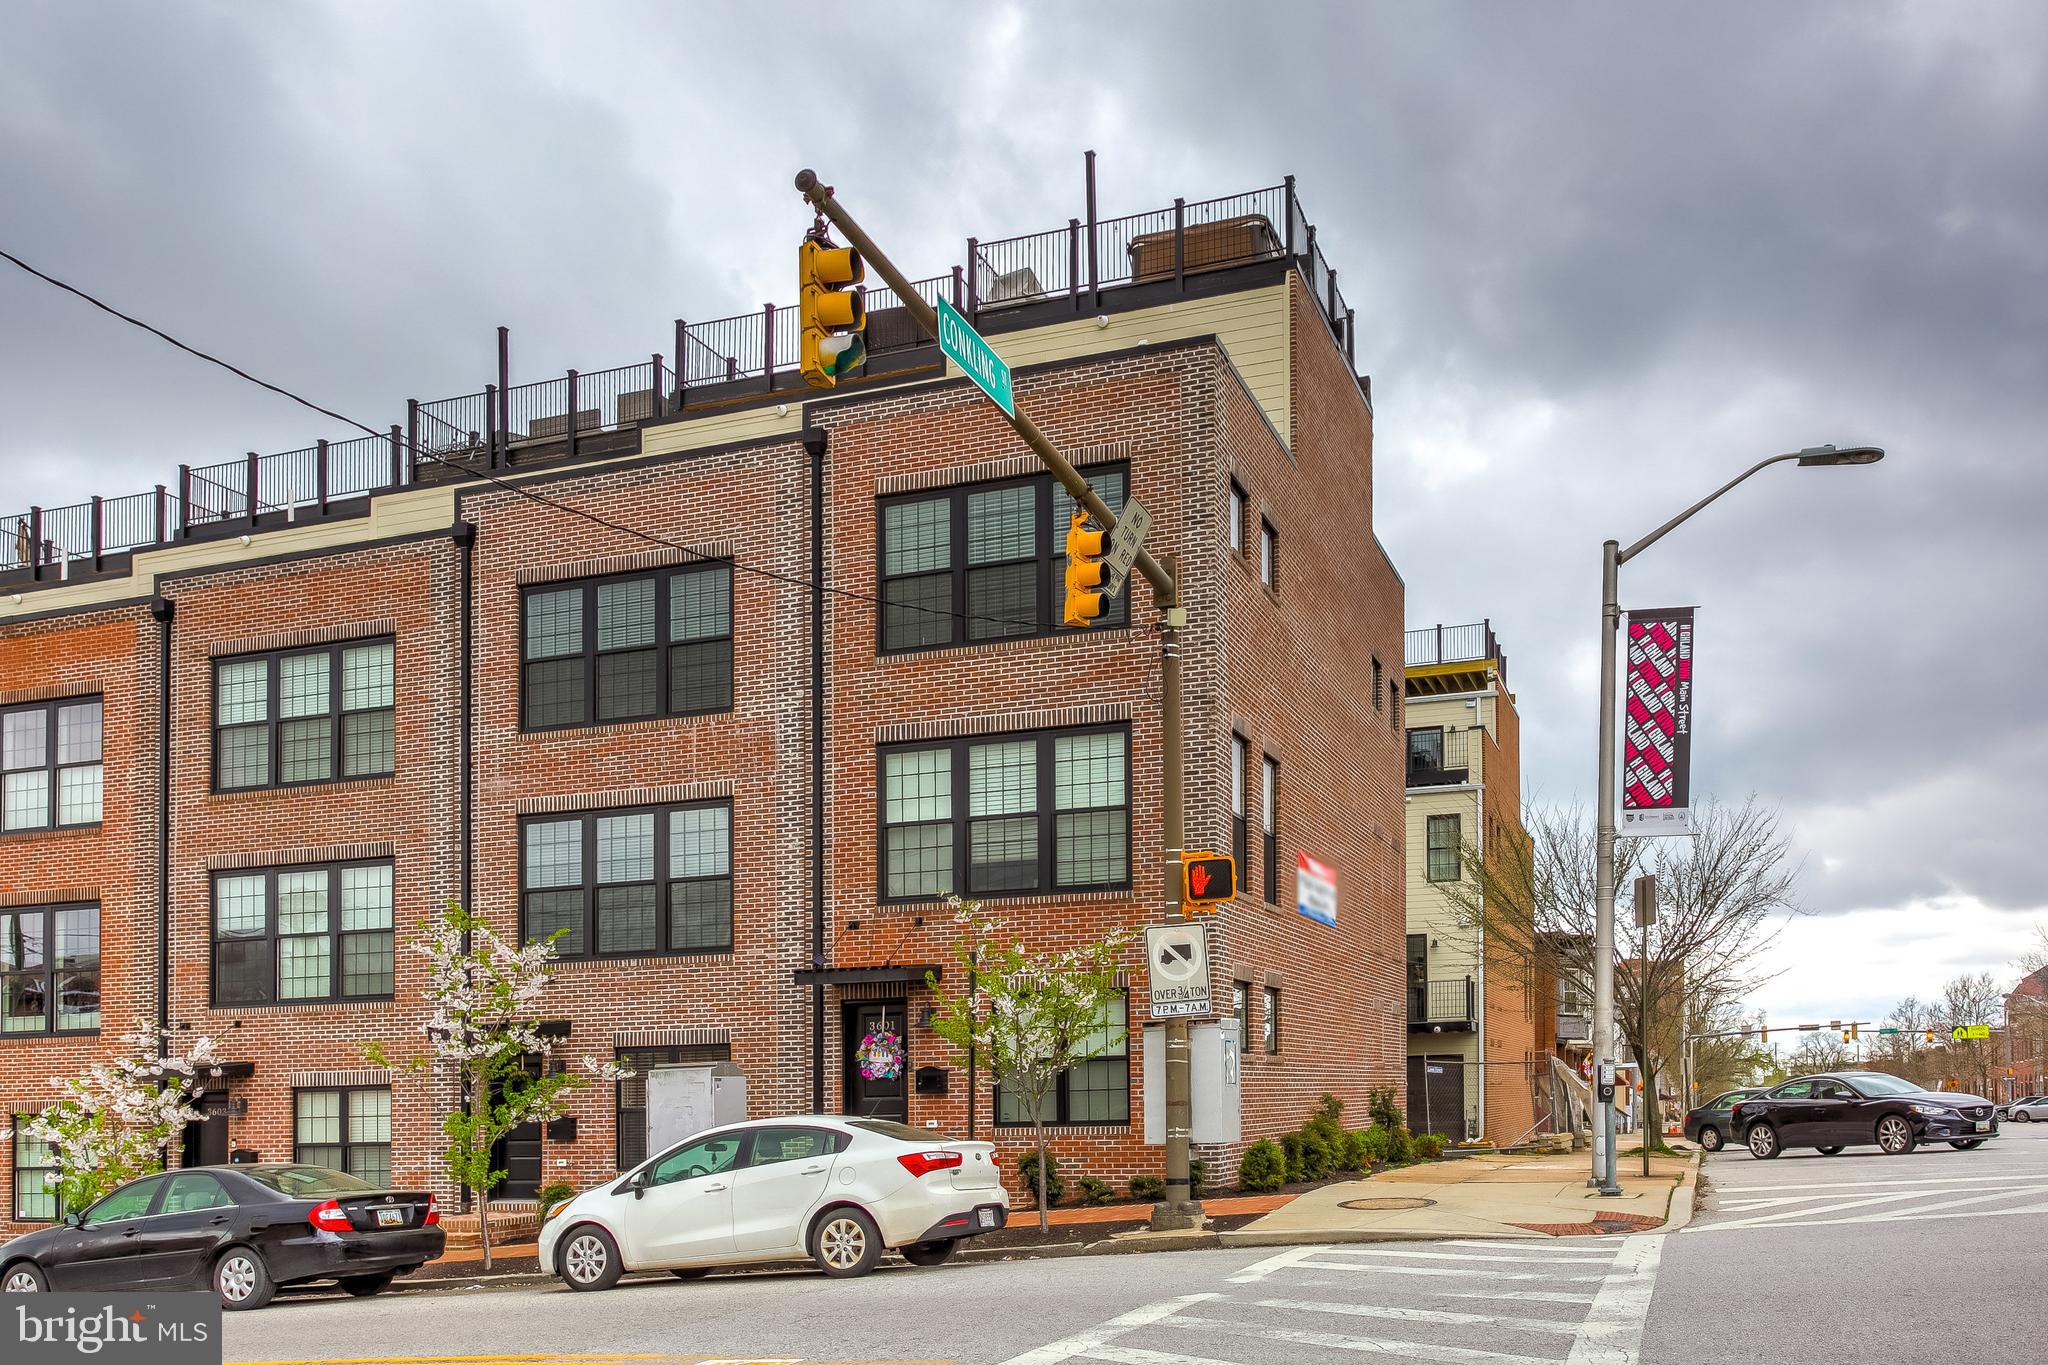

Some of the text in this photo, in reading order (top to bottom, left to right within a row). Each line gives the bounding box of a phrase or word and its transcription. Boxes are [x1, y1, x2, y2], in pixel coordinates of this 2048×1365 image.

[943, 312, 996, 389] CONKLING
[1131, 511, 1143, 529] NO
[1120, 525, 1139, 549] TURN
[1119, 548, 1132, 567] RED
[1680, 681, 1690, 702] Main
[1676, 704, 1690, 735] Street
[1154, 988, 1177, 1001] OVER
[1190, 985, 1207, 997] TON
[869, 1020, 895, 1031] 3601
